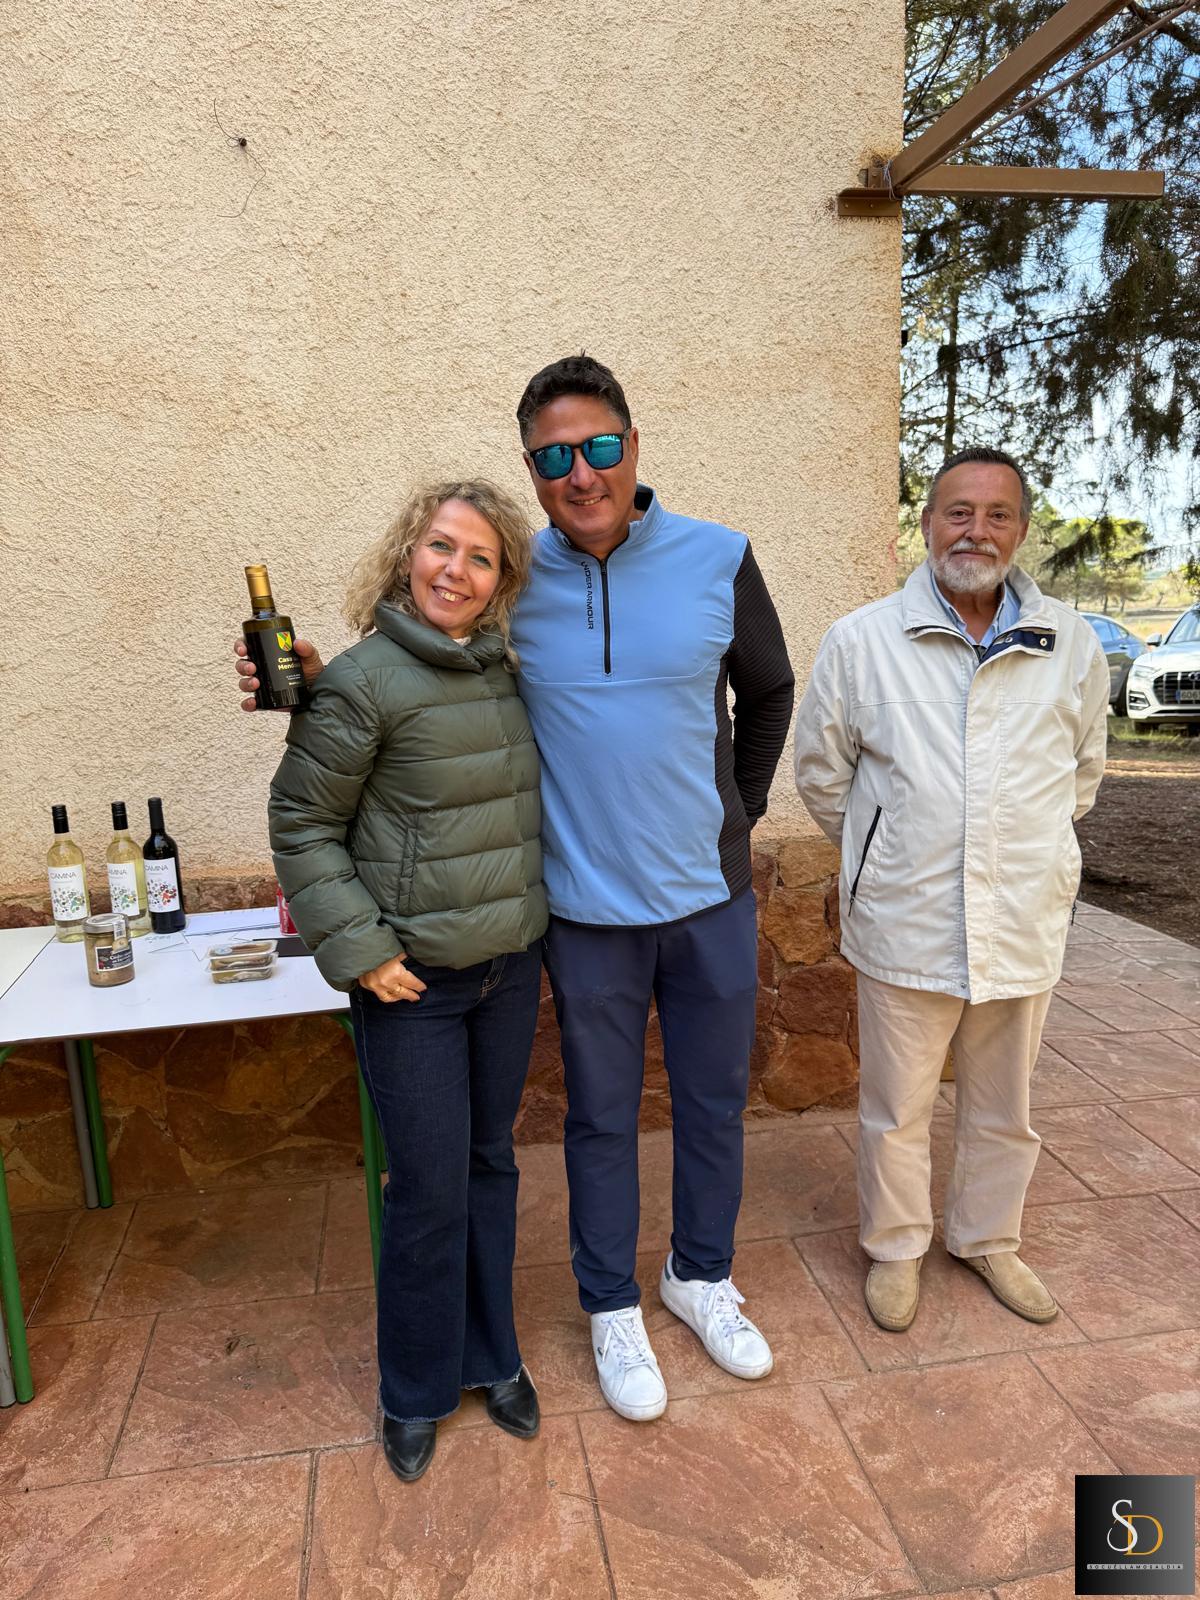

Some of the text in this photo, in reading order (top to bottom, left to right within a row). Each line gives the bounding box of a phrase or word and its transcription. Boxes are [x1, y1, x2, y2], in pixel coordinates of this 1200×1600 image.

[580, 561, 594, 630] UNDER ARMOUR
[50, 871, 77, 879] CAMINA
